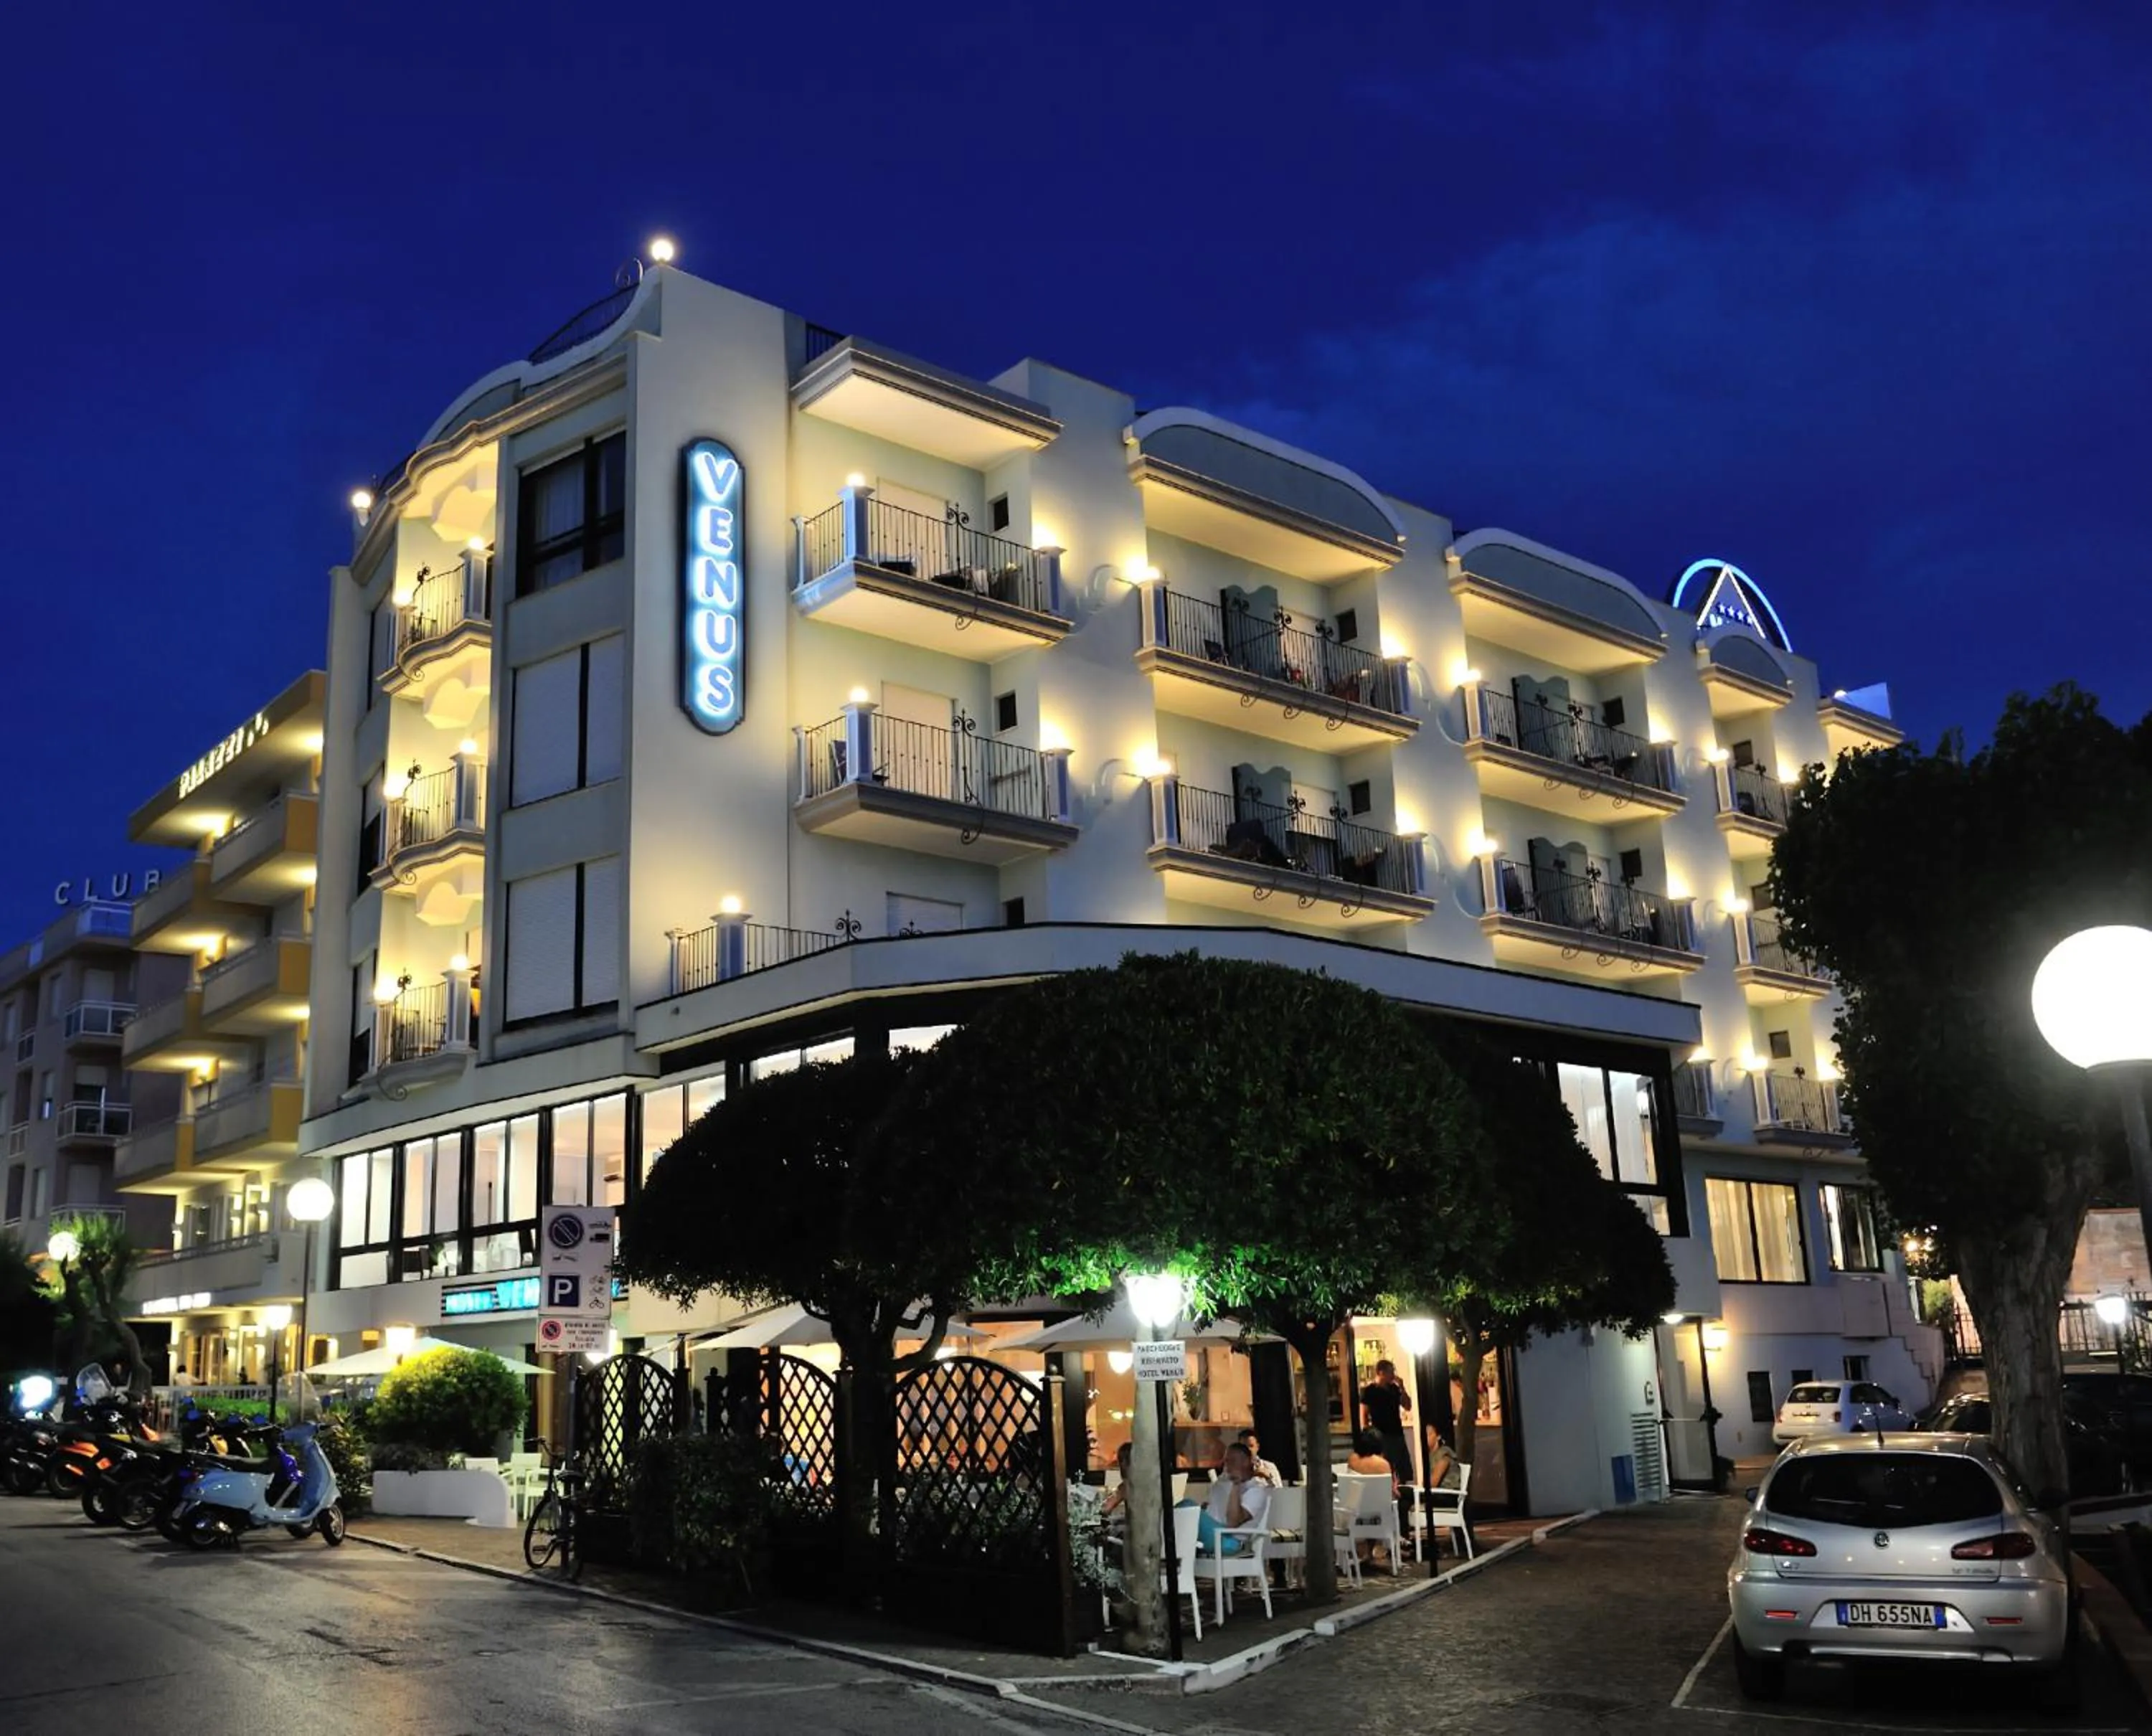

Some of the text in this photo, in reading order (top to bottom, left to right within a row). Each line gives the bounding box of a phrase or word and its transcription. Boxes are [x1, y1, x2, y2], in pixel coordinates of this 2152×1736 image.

[696, 451, 738, 712] VENUS
[55, 869, 159, 905] CLUB
[553, 1278, 573, 1304] P
[1138, 1369, 1159, 1377] HOTEL
[1850, 1605, 1932, 1624] DH 655NA
